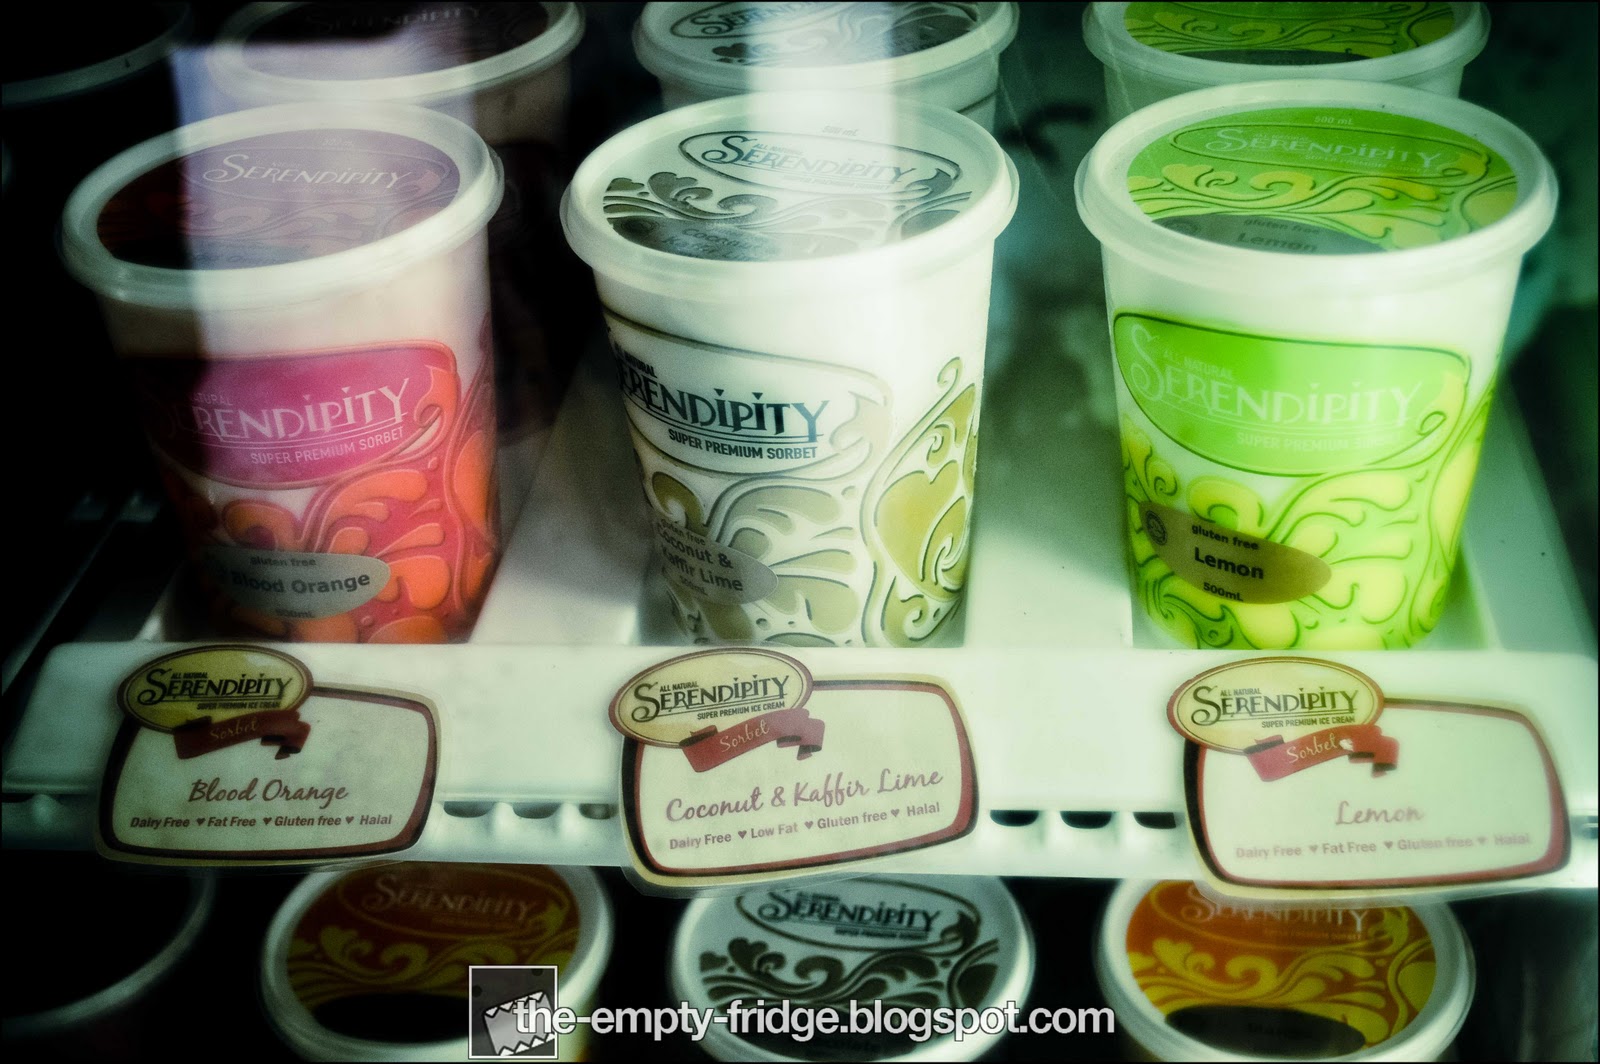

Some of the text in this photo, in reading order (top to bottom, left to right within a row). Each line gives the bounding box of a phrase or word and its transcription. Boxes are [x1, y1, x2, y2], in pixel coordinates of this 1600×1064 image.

[701, 134, 916, 184] SERENDIPITY
[1205, 127, 1442, 169] SERENDIPITY
[203, 153, 412, 189] SERENDIPITY
[1236, 231, 1318, 253] Lemon
[1130, 323, 1424, 428] SERENDIPITY
[1184, 356, 1235, 380] NATURAL
[617, 357, 830, 443] ERENDIPITY
[251, 426, 405, 465] SUPER PREMIUM SORBET
[668, 428, 818, 460] SUPER PREMIUM SORBET
[1236, 432, 1281, 450] SUPER
[1284, 439, 1349, 452] PREMIUM
[1191, 524, 1260, 550] gluten free
[290, 557, 317, 567] free
[718, 552, 734, 569] &
[1193, 547, 1265, 580] Lemon
[230, 569, 371, 595] Blood Orange
[699, 567, 743, 592] Lime
[1203, 581, 1244, 602] 500mL
[137, 668, 293, 706] SERENDIPITY
[170, 671, 208, 680] ALL NATURAL
[659, 681, 699, 693] ALL NATURAL
[631, 674, 790, 723] SERENDIPITY
[1220, 687, 1262, 697] ALL NATURAL
[196, 702, 217, 711] SUPER
[217, 701, 247, 710] PREMIUM
[248, 701, 258, 709] ICE
[697, 700, 786, 721] SUPER PREMIUM ICE CREAM
[1191, 685, 1359, 727] SERENDIPITY
[209, 715, 259, 742] Sorbet
[1261, 715, 1356, 729] SUPER PREMIUM ICE CREAM
[719, 719, 770, 753] Sorbet
[1286, 732, 1338, 764] Sorbet
[188, 777, 348, 810] Blood Orange
[665, 768, 944, 823] Coconut & Kaffir Lime
[130, 814, 392, 829] Dairy Free Fat Free Gluten free Halal
[1335, 800, 1425, 825] Lemon
[669, 801, 941, 851] Dairy Free Low Fat Gluten free Halal
[1236, 846, 1271, 860] Dairy
[1273, 845, 1302, 857] Free
[1322, 842, 1345, 855] Fat
[1348, 841, 1377, 853] Free
[1397, 838, 1443, 851] Gluten
[1445, 835, 1474, 848] free
[757, 890, 941, 932] SERENDIPITY
